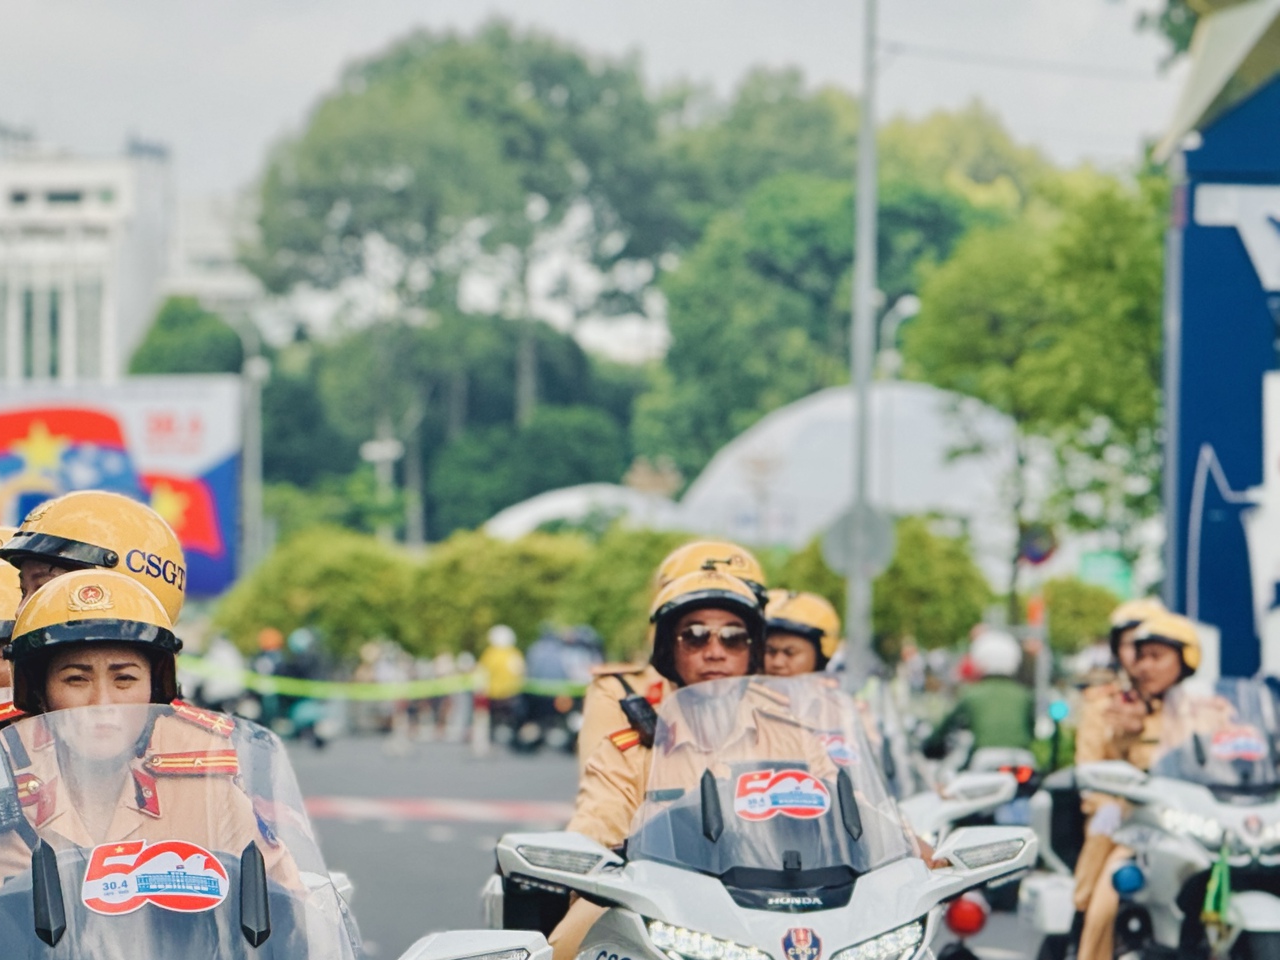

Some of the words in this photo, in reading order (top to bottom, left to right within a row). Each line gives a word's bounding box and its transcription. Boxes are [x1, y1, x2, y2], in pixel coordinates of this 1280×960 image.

[126, 549, 186, 592] CSGT
[102, 880, 128, 891] 30.4
[767, 896, 823, 905] HONDA
